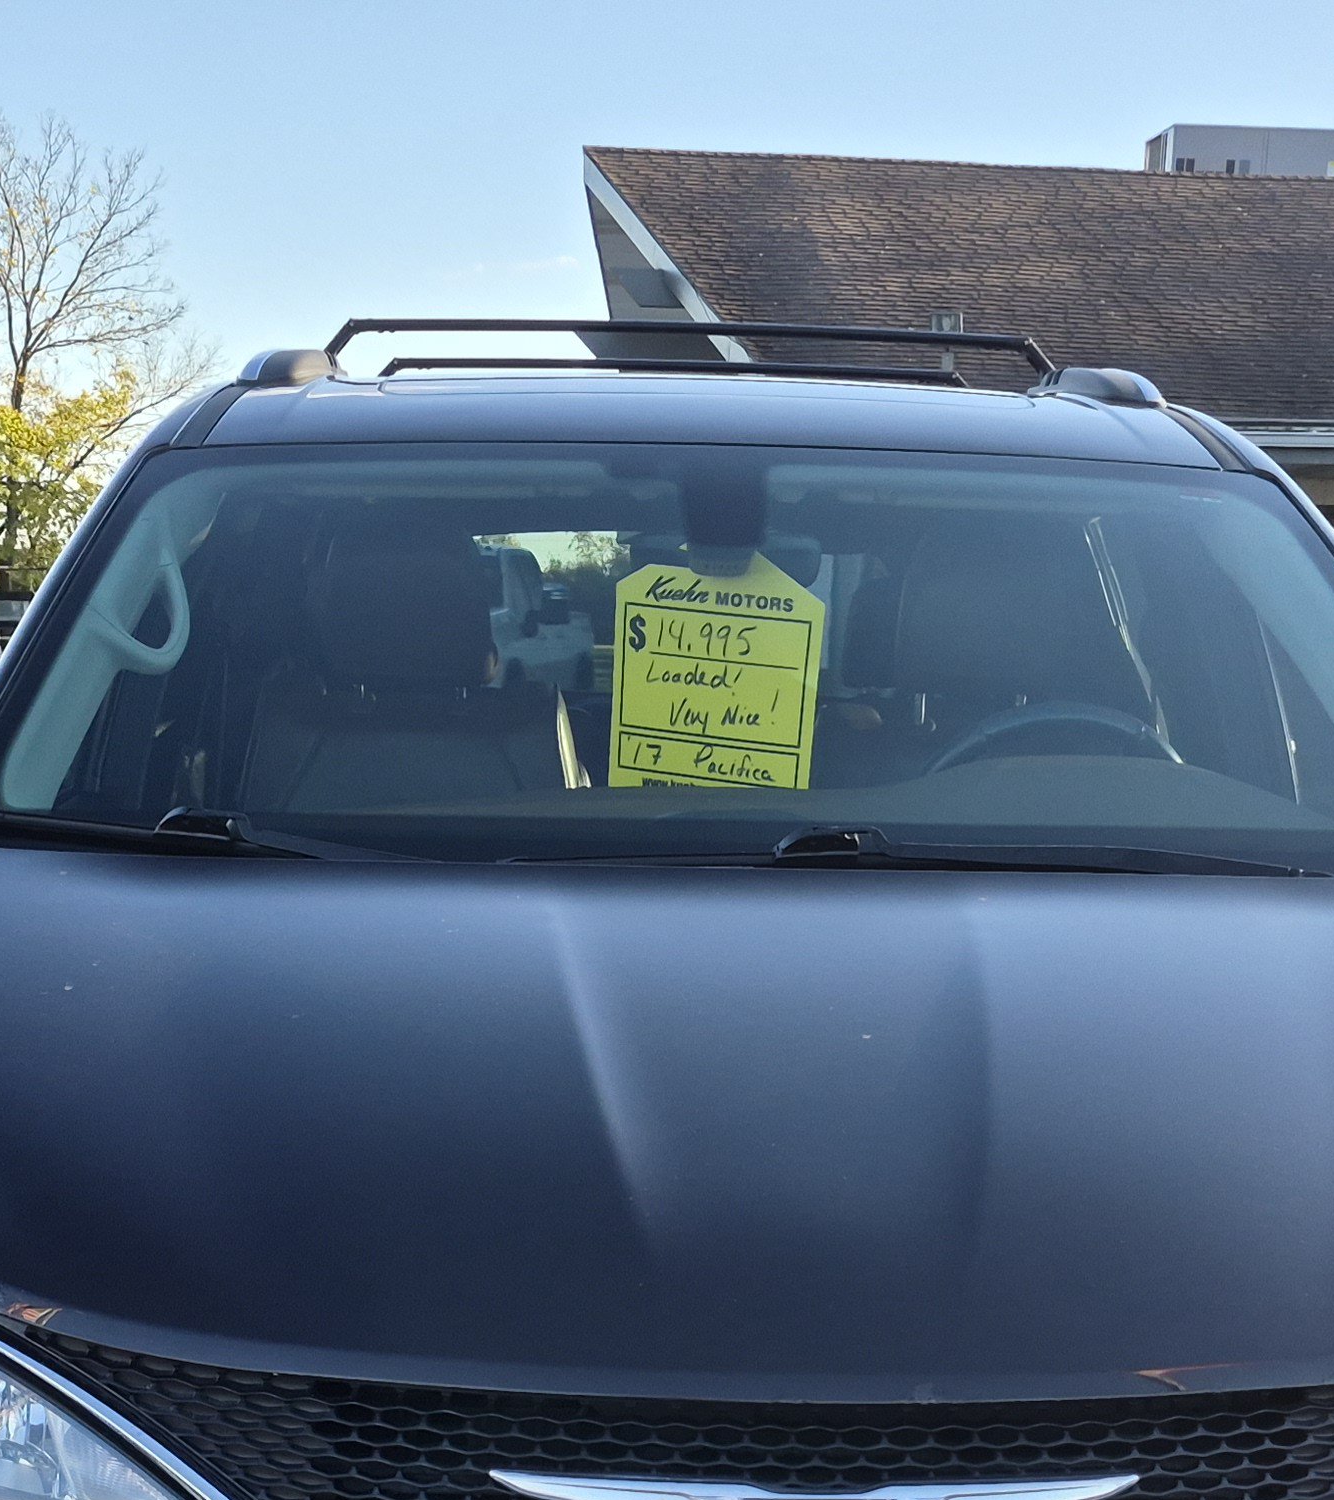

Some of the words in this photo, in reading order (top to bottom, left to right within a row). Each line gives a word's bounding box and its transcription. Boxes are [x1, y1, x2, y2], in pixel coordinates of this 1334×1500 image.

[645, 575, 709, 602] Kuehn
[715, 591, 794, 612] MOTORS
[646, 660, 742, 696] Loaded!
[670, 698, 709, 733] Very
[694, 744, 776, 782] Pacifica
